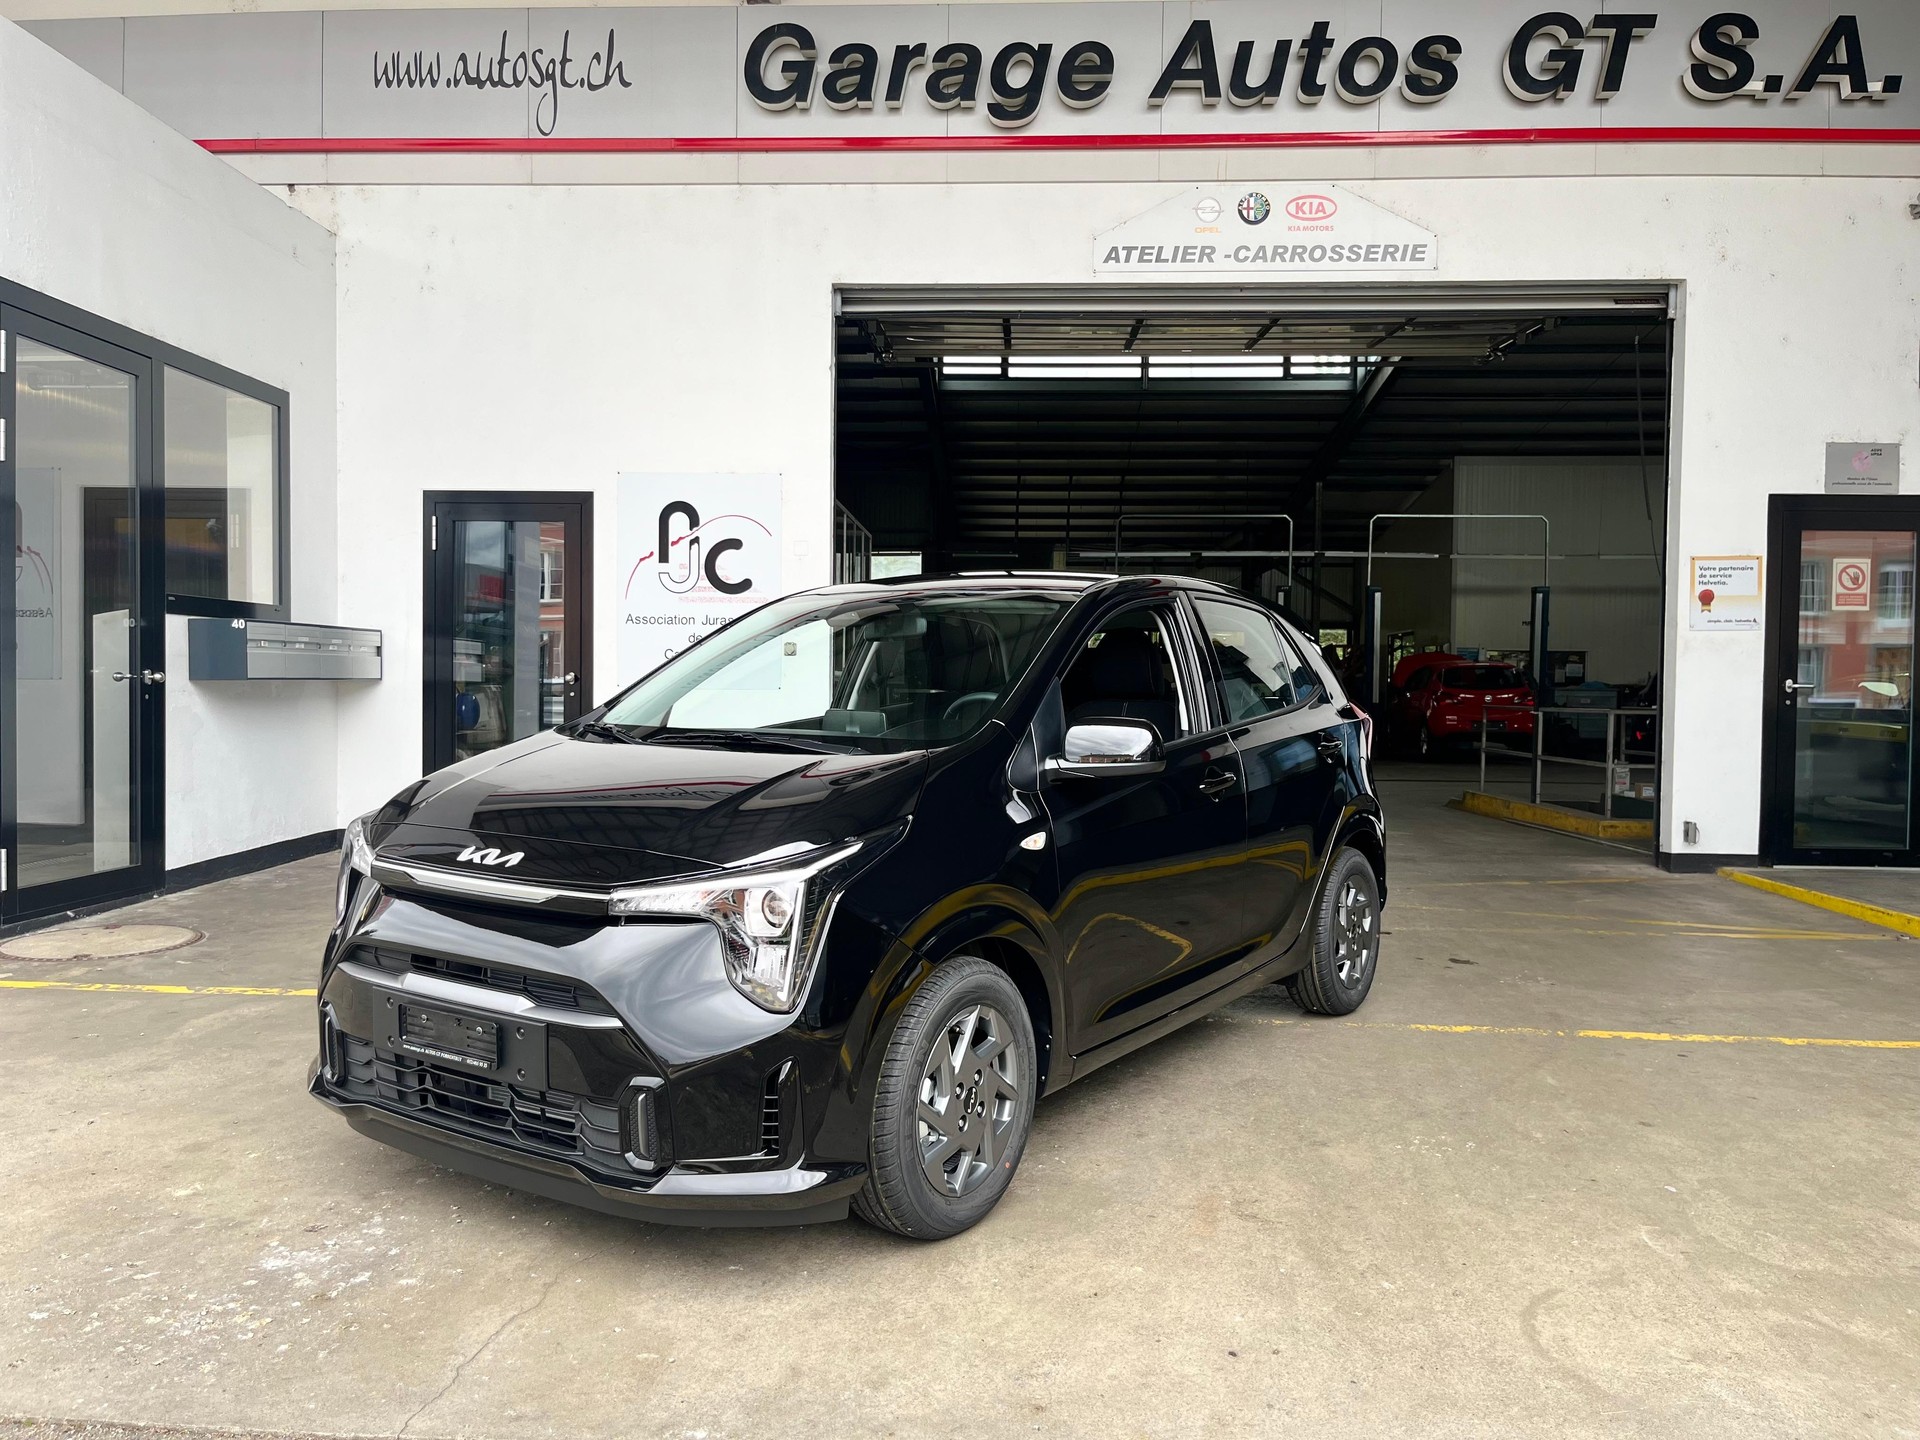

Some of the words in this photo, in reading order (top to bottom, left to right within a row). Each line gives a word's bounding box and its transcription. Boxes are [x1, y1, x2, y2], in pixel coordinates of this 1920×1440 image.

[744, 22, 1115, 128] Garage
[1148, 20, 1462, 108] Autos
[1503, 11, 1658, 103] GT
[1682, 12, 1903, 104] S.A.
[373, 28, 633, 137] www.autosgt.ch
[1294, 201, 1328, 215] KIA
[1195, 226, 1221, 234] OPEL
[1102, 245, 1217, 264] ATELIER
[1718, 564, 1754, 573] partenaire
[231, 618, 246, 629] 40
[625, 613, 696, 626] Association
[456, 846, 525, 868] KIA
